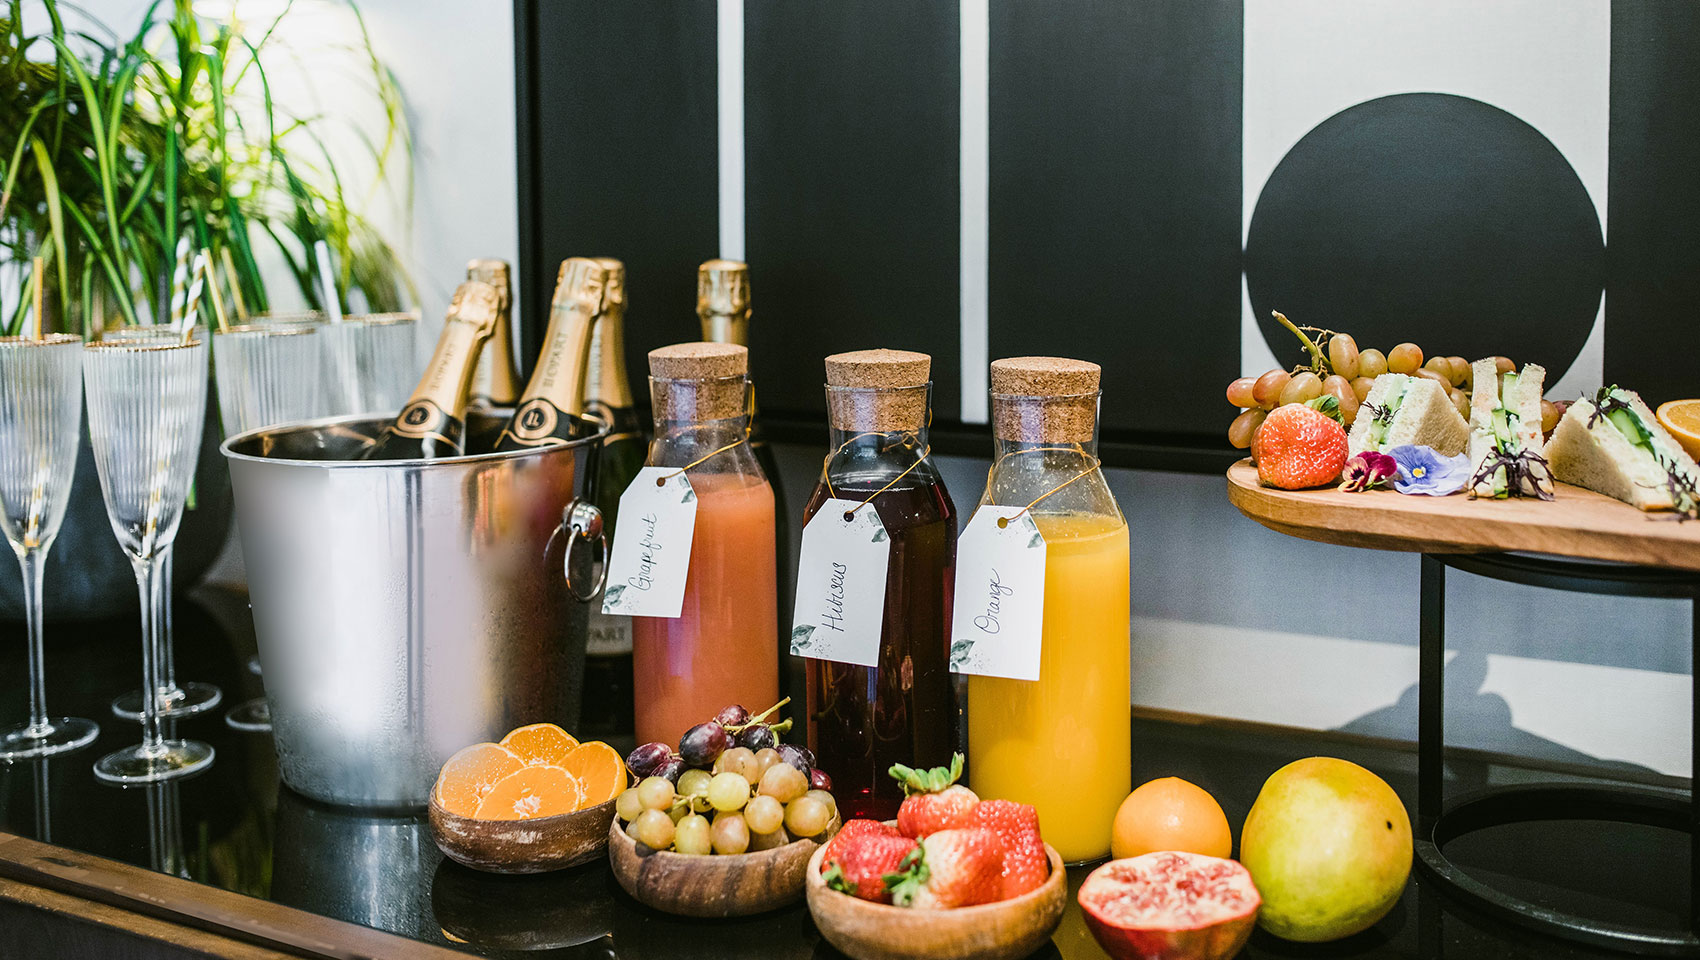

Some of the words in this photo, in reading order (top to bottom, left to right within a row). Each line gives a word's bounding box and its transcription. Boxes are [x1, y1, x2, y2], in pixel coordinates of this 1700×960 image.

[627, 512, 662, 591] Grapefruit
[821, 561, 847, 632] Hibiscus
[973, 567, 1014, 634] Orange
